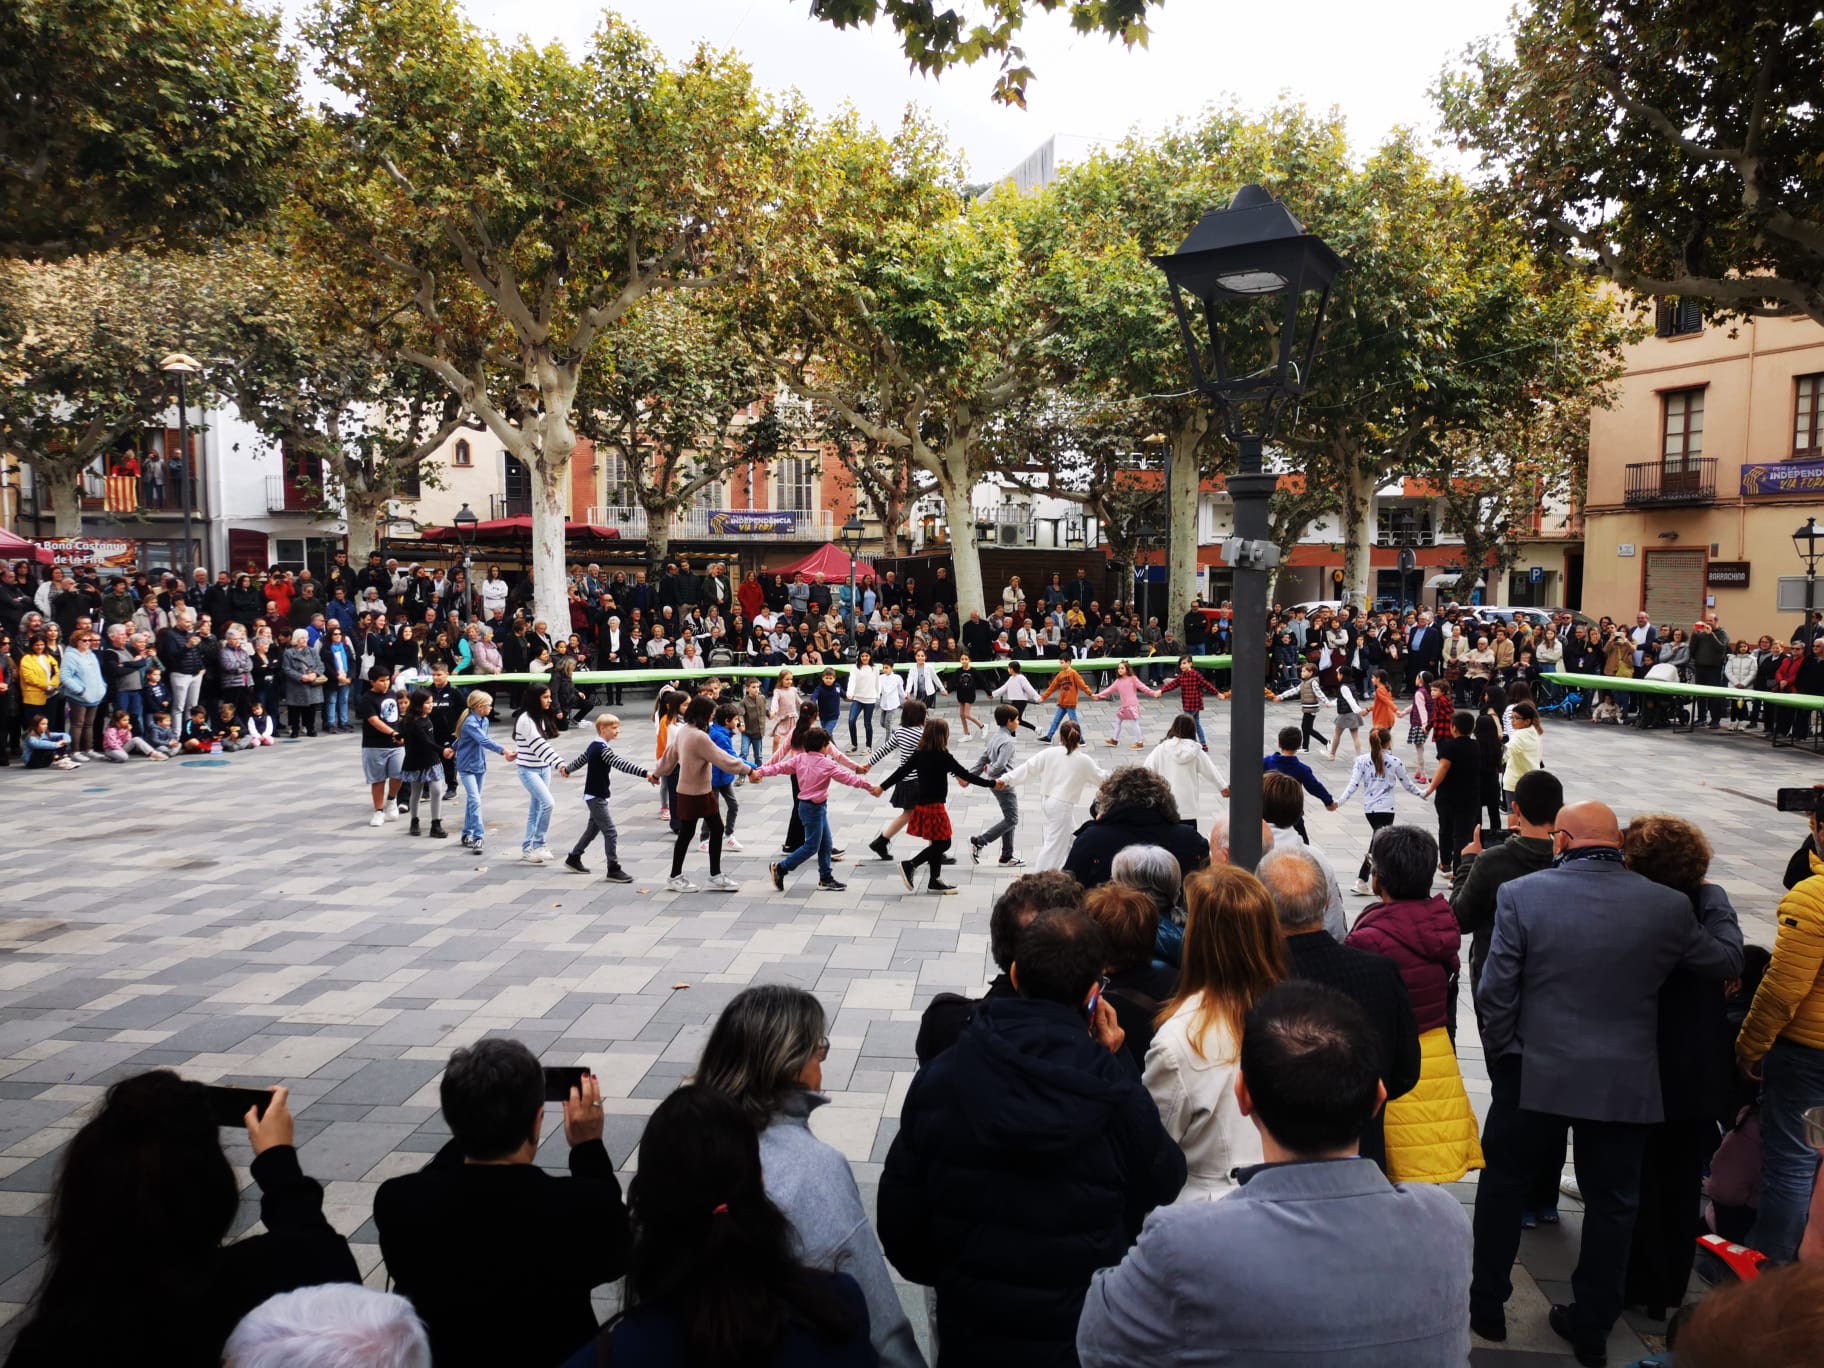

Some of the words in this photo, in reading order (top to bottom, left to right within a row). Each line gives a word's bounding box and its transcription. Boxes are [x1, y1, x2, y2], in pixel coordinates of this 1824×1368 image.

[1769, 468, 1824, 480] INDEPEND
[43, 541, 73, 551] Bona
[54, 555, 68, 564] de
[1532, 569, 1541, 581] P
